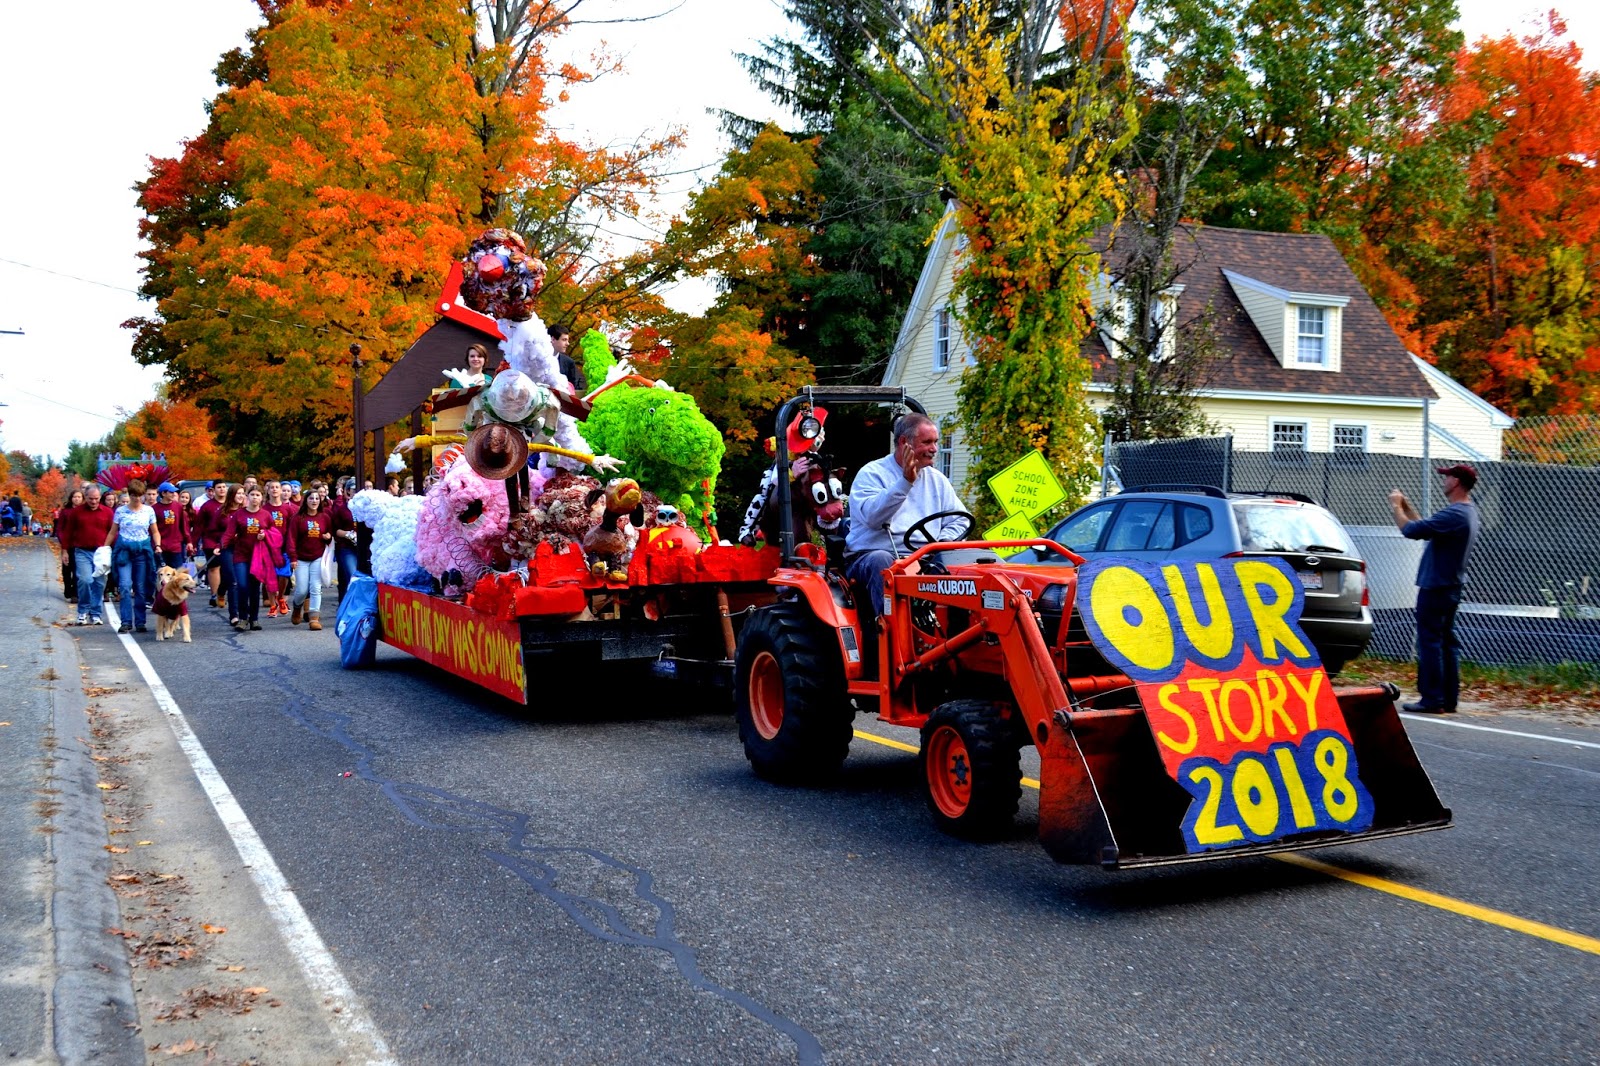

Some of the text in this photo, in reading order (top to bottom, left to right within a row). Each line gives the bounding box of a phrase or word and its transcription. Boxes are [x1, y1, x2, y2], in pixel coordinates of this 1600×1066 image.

[1013, 471, 1046, 485] SCHOOL
[1015, 484, 1038, 496] ZONE
[1009, 497, 1038, 509] AHEAD
[1002, 527, 1030, 539] DRIVE
[937, 580, 977, 596] KUBOTA
[1090, 561, 1311, 670] OUR
[412, 600, 432, 652] THIS
[433, 611, 450, 657] DAY
[451, 620, 478, 674] WAS
[478, 622, 524, 692] COMING
[1157, 669, 1323, 754] STORY
[1188, 736, 1358, 845] 2018
